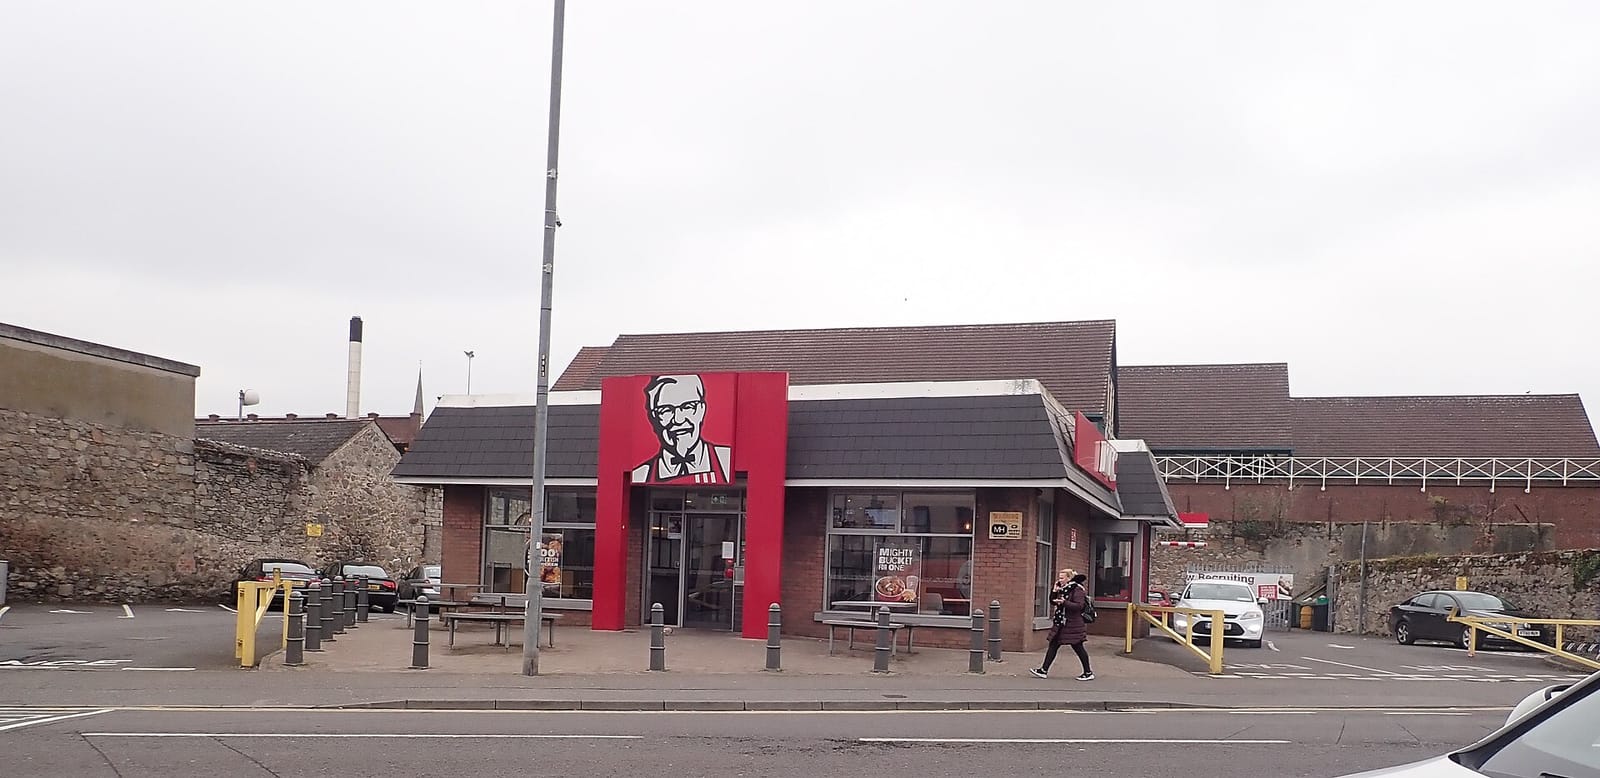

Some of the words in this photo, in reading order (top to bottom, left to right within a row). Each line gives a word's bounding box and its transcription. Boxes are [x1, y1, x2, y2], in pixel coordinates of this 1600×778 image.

[880, 548, 913, 557] MIGHTY
[879, 556, 912, 565] BUCKET
[1199, 573, 1255, 585] Recruiting
